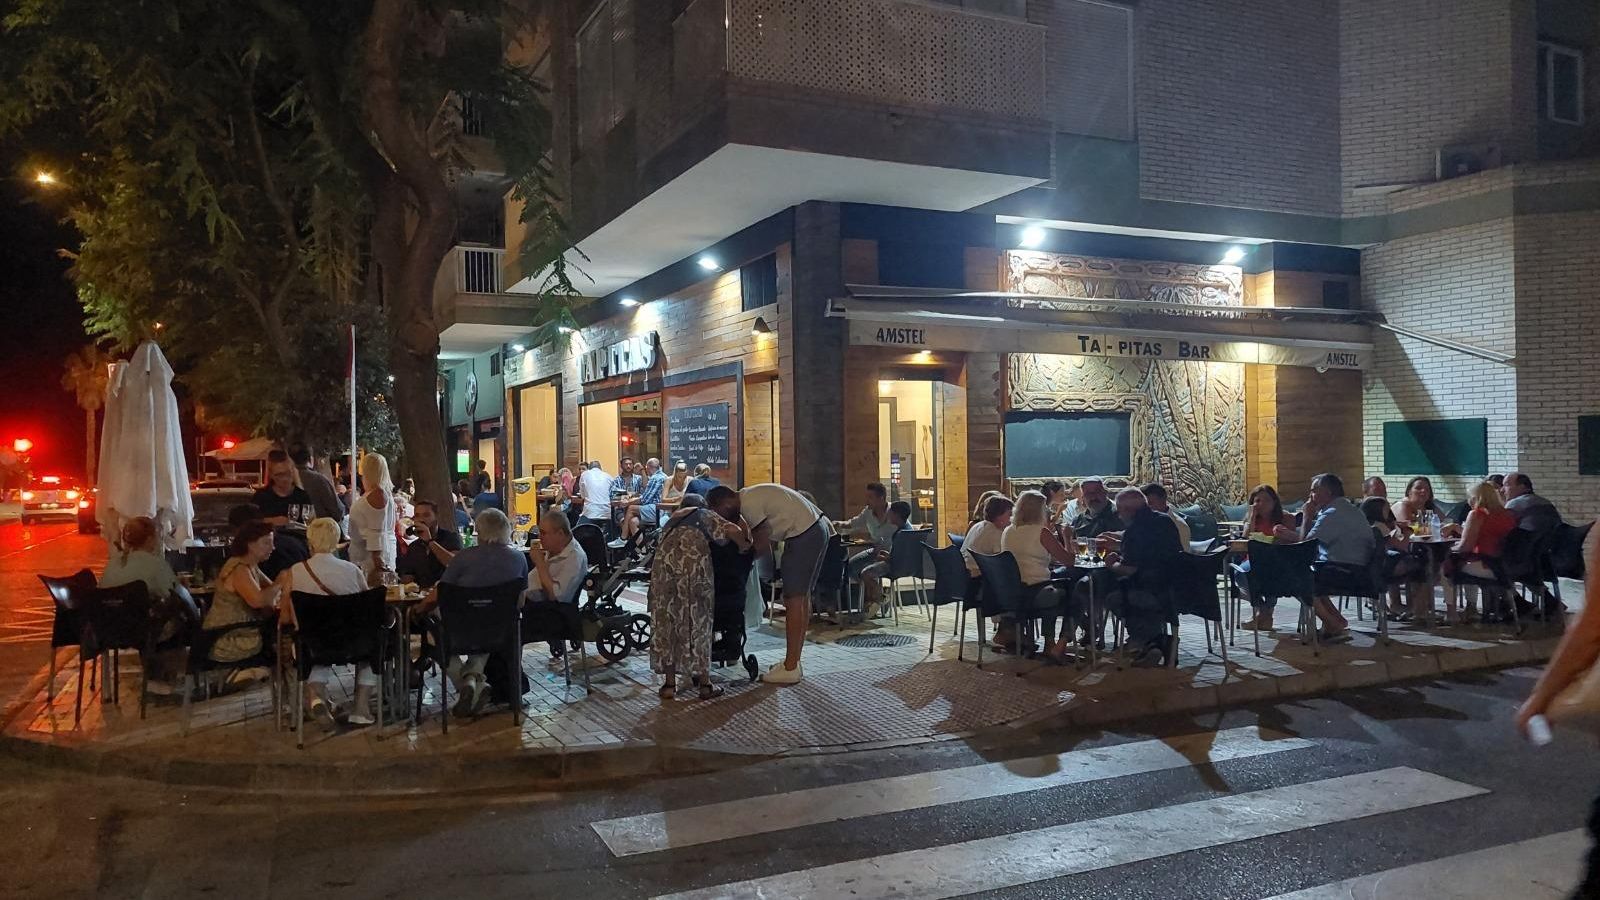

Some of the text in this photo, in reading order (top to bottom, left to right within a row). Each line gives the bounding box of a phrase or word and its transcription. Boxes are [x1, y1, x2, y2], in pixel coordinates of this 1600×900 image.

[876, 327, 926, 345] AMSTEL
[1178, 341, 1210, 359] BAR
[1326, 352, 1359, 367] AMSTEL
